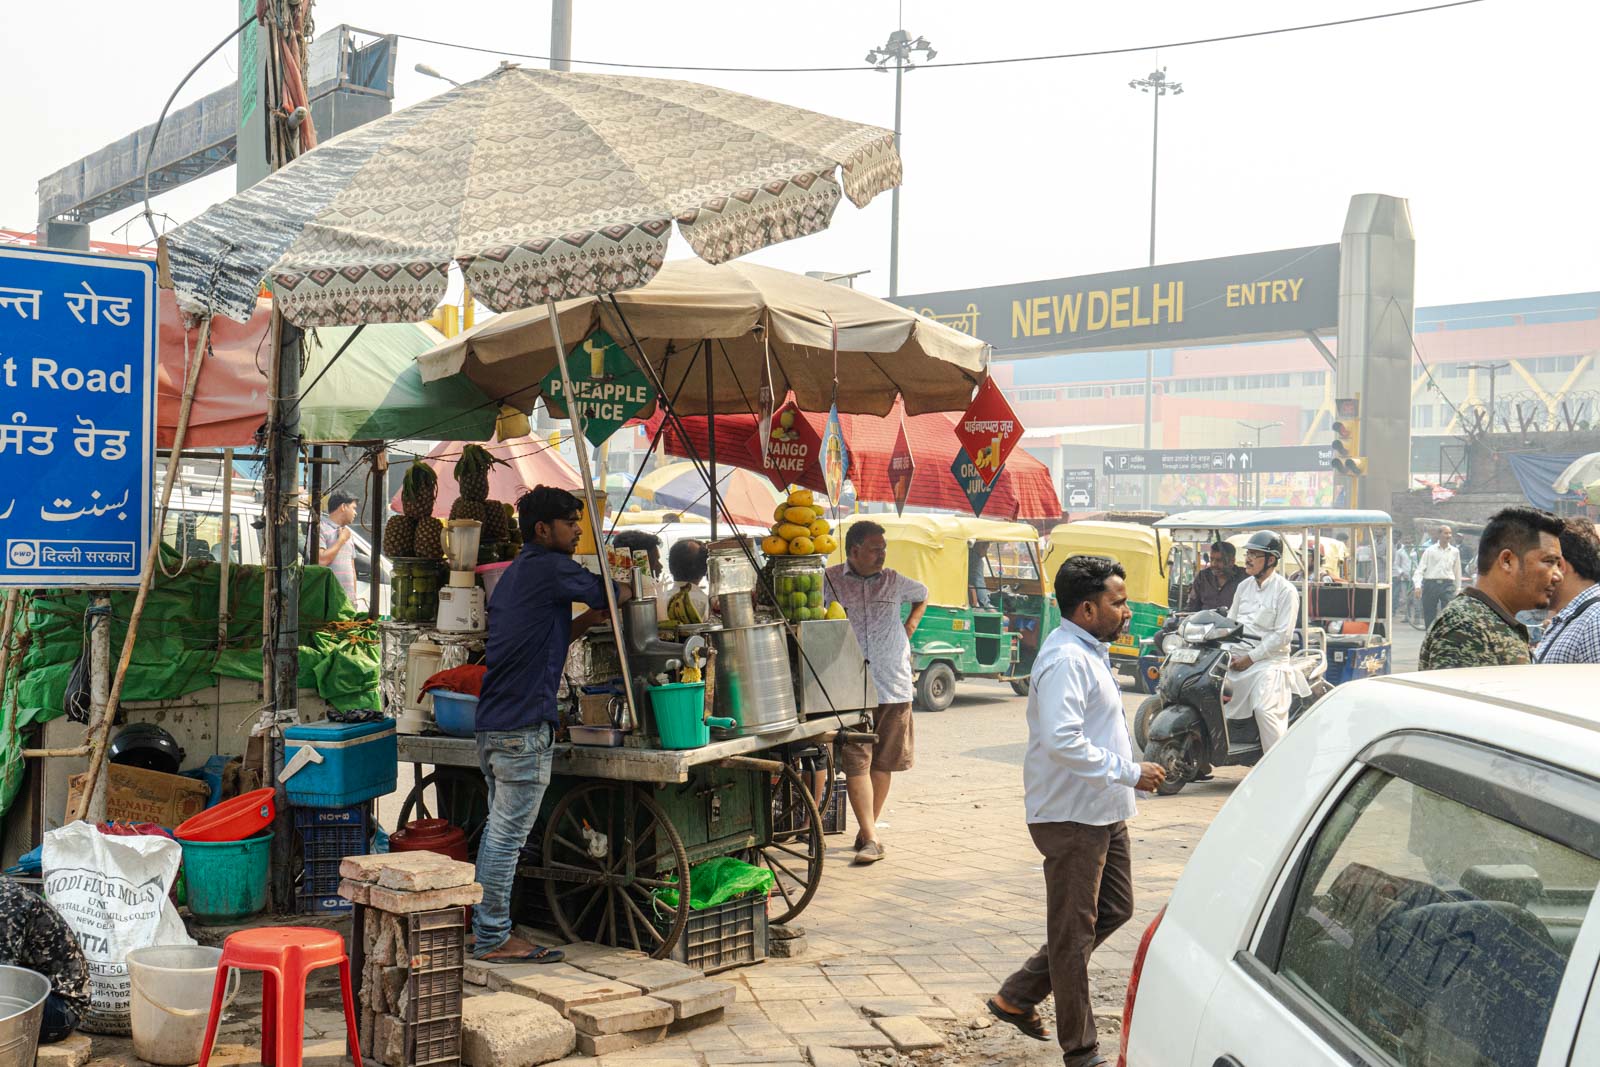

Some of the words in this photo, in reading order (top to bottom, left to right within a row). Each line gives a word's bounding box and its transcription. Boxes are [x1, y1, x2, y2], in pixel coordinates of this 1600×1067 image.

[64, 281, 132, 327] रोड
[1226, 278, 1304, 308] ENTRY
[1012, 292, 1083, 338] NEW
[1087, 281, 1183, 331] DELHI
[32, 357, 132, 394] Road
[550, 380, 647, 403] PNEAPPLE
[0, 411, 58, 455] ਸੰਤ
[41, 488, 129, 522] بسنت
[41, 546, 81, 563] दिल्ली
[84, 551, 131, 563] सरकार
[107, 807, 142, 822] FRUIT
[117, 884, 155, 906] MILLS
[76, 916, 95, 926] NEW
[110, 965, 123, 974] 50
